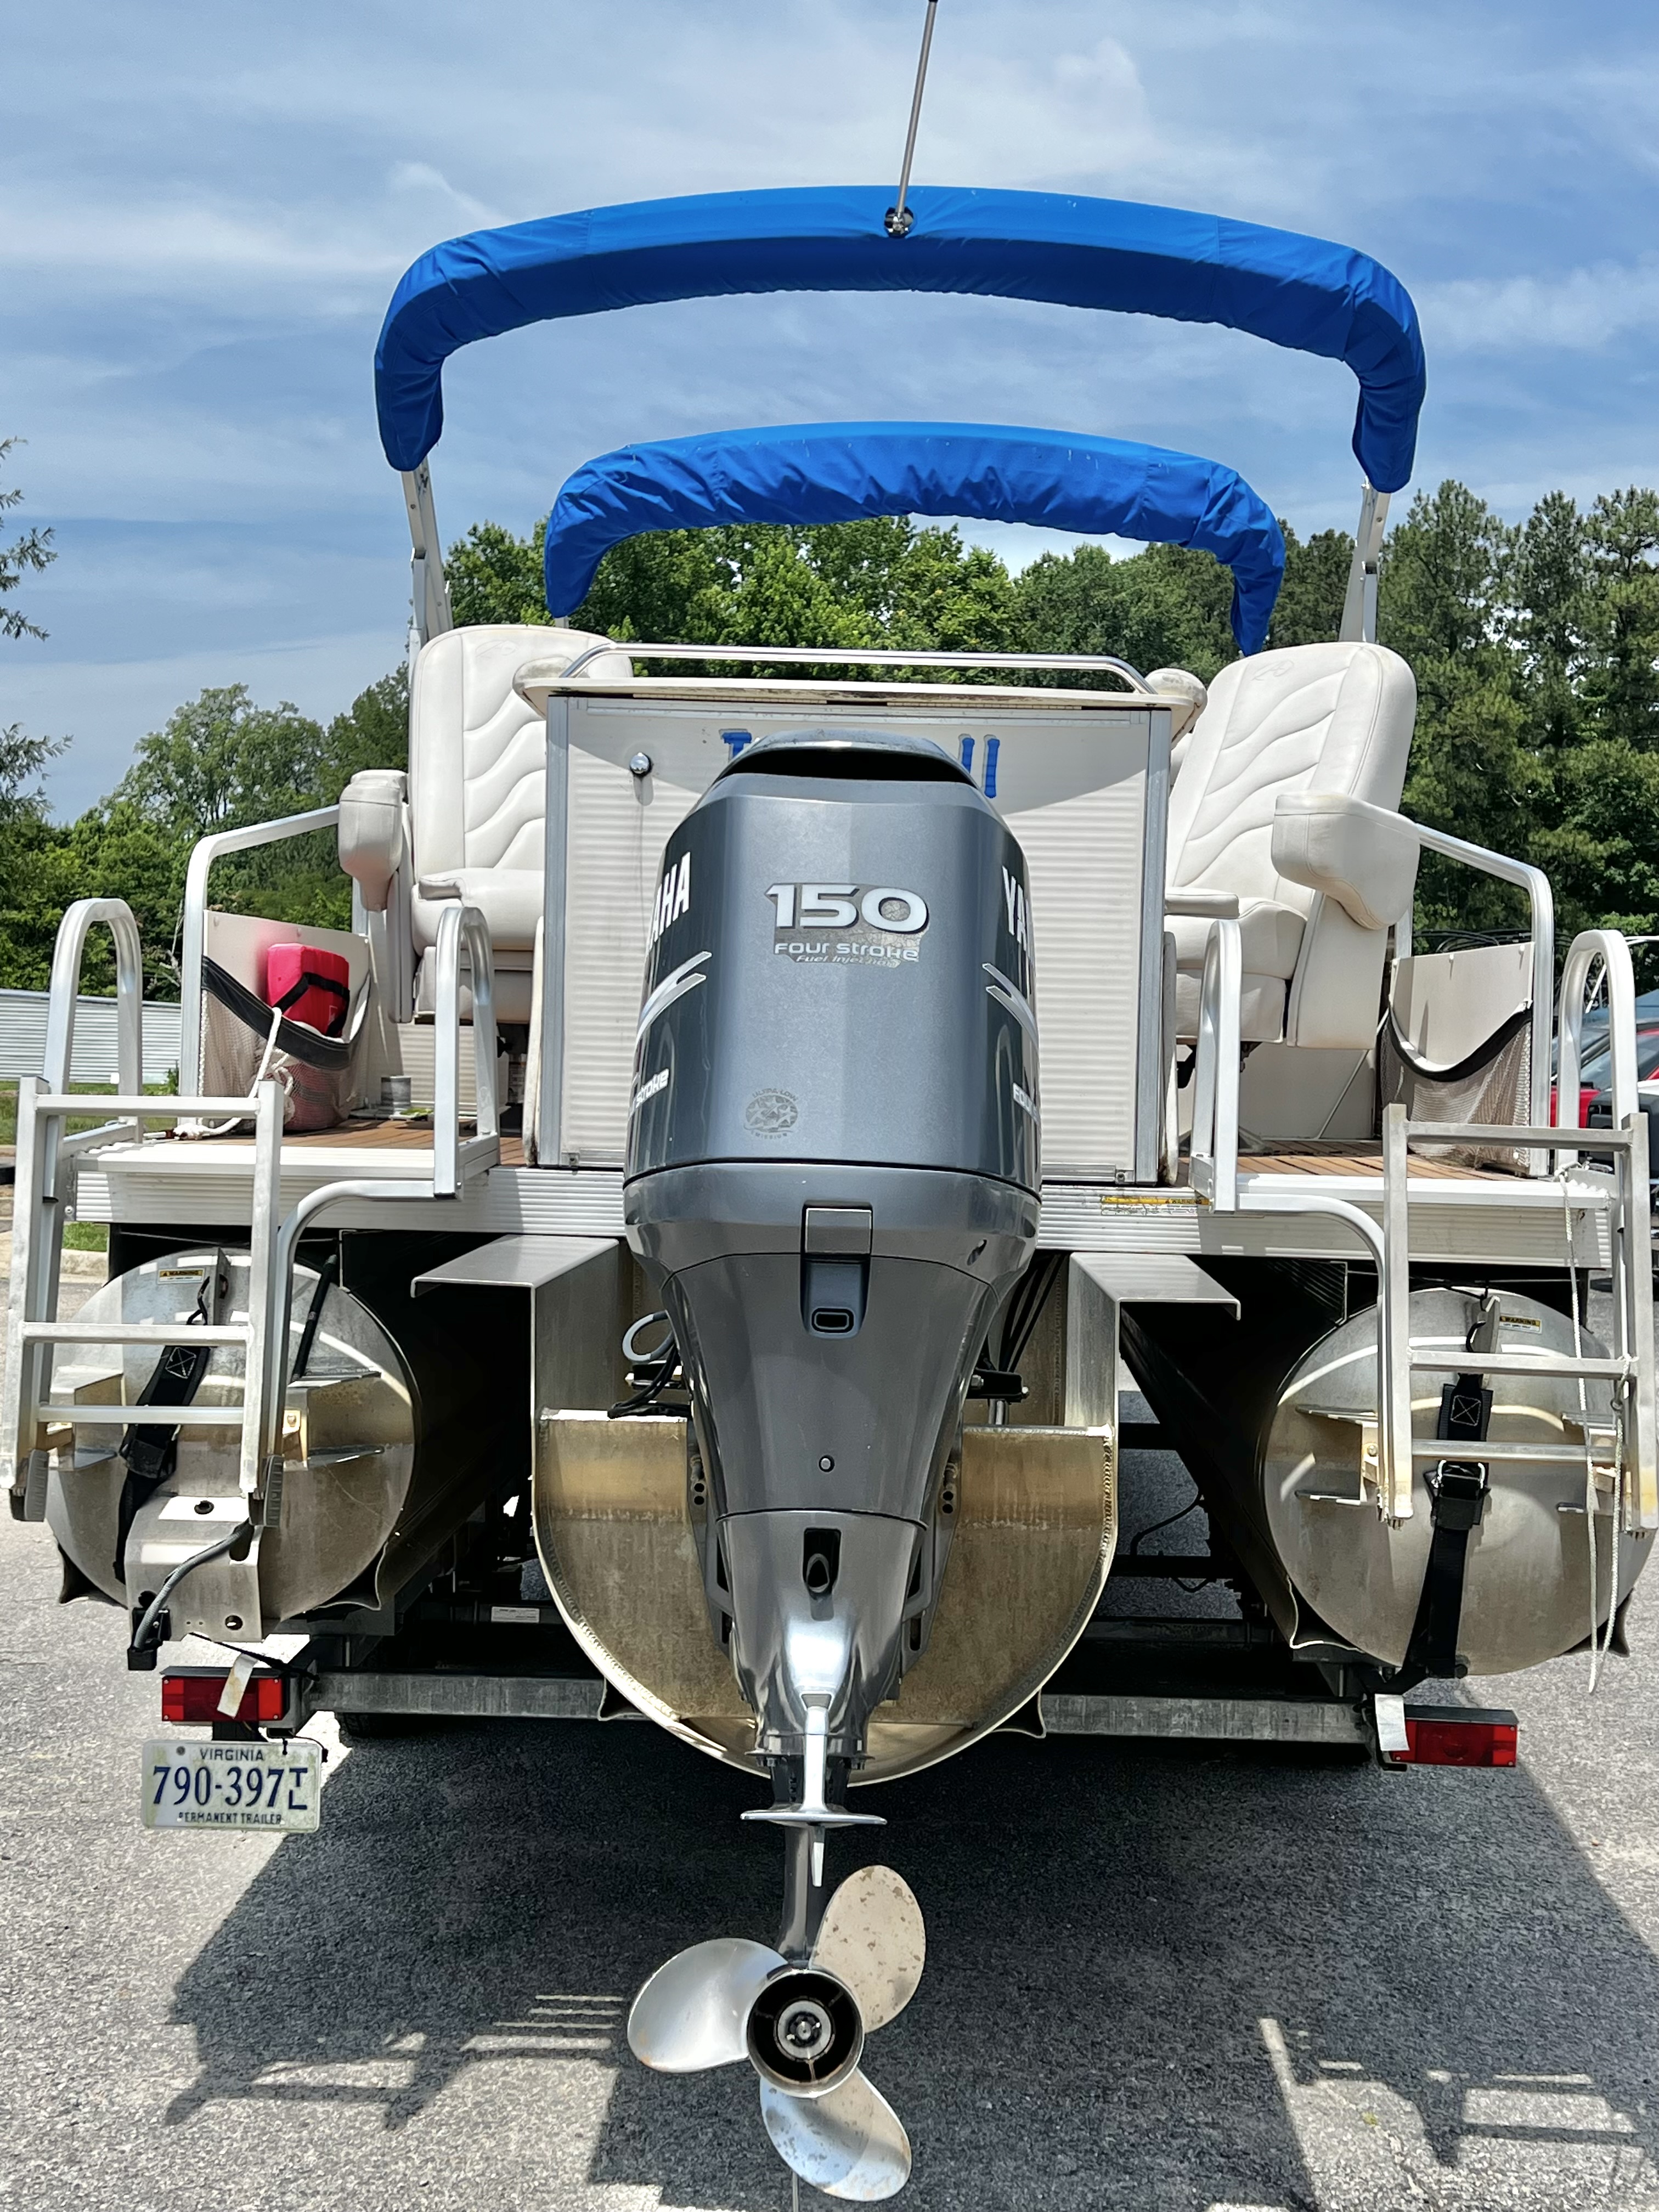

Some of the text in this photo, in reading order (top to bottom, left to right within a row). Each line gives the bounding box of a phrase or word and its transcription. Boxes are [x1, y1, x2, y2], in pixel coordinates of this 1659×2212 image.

[648, 851, 691, 951] AHA
[766, 884, 929, 935] 150
[199, 1748, 264, 1762] VIRGINIA
[241, 1813, 283, 1825] TRAILER
